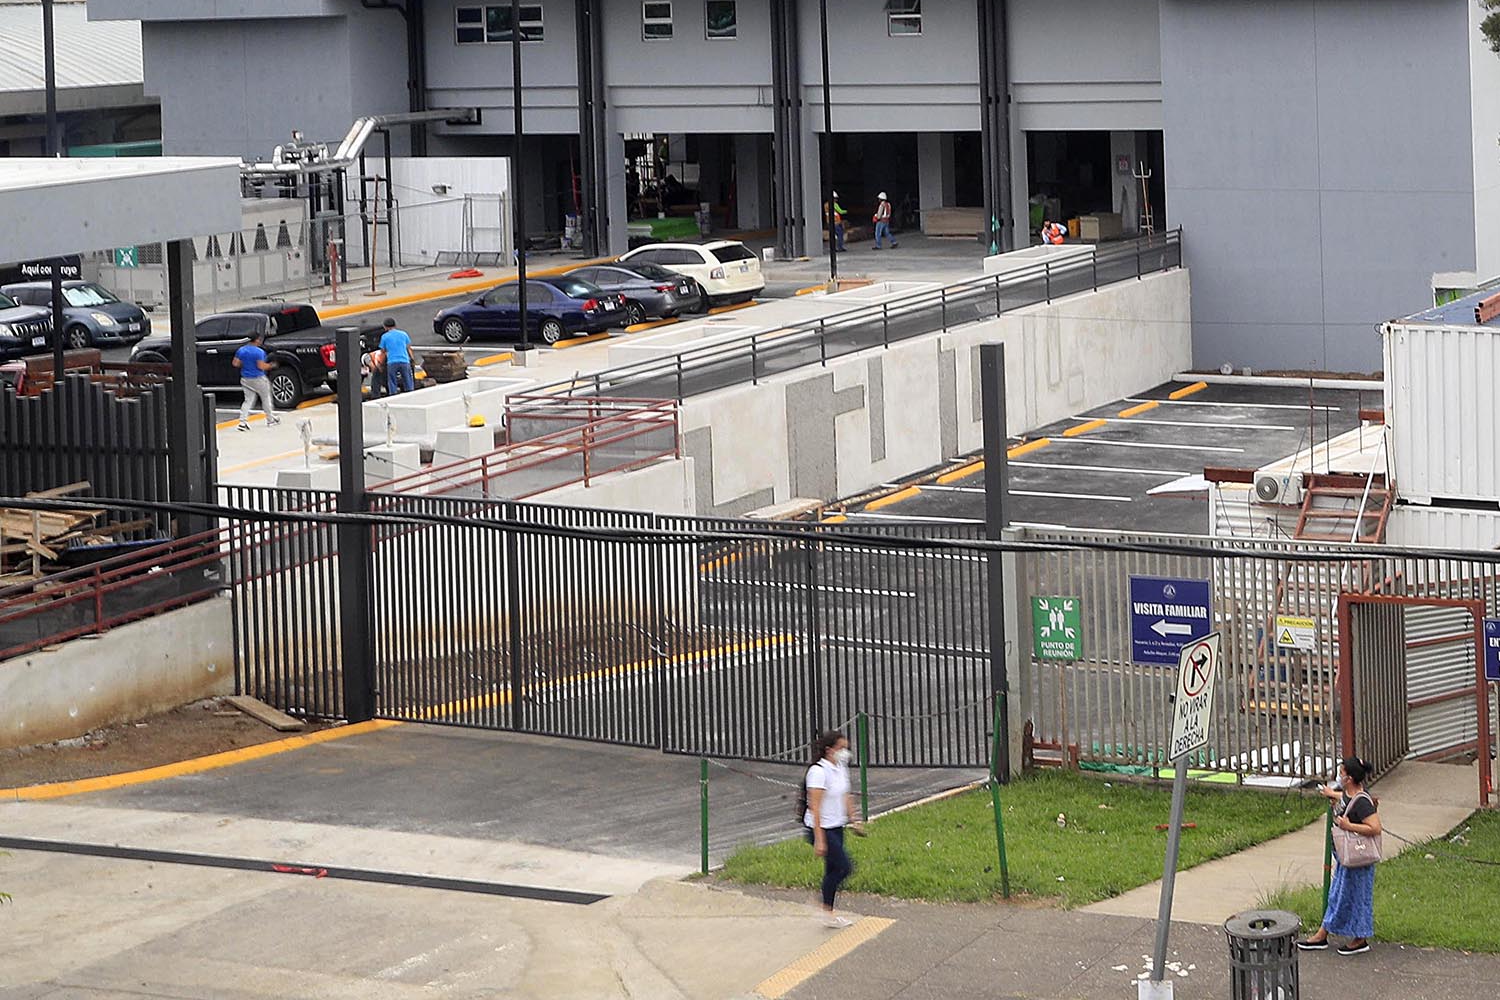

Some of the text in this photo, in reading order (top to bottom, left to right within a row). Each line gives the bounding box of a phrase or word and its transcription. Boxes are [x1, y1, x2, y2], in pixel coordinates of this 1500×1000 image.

[1133, 602, 1207, 619] VISITA FAMILIAR
[1040, 641, 1075, 650] PUNTO DE
[1043, 648, 1074, 658] REUNIÓN
[1179, 692, 1208, 720] NO VIRAR
[1184, 713, 1198, 734] A LA
[1174, 727, 1204, 754] DERECHA
